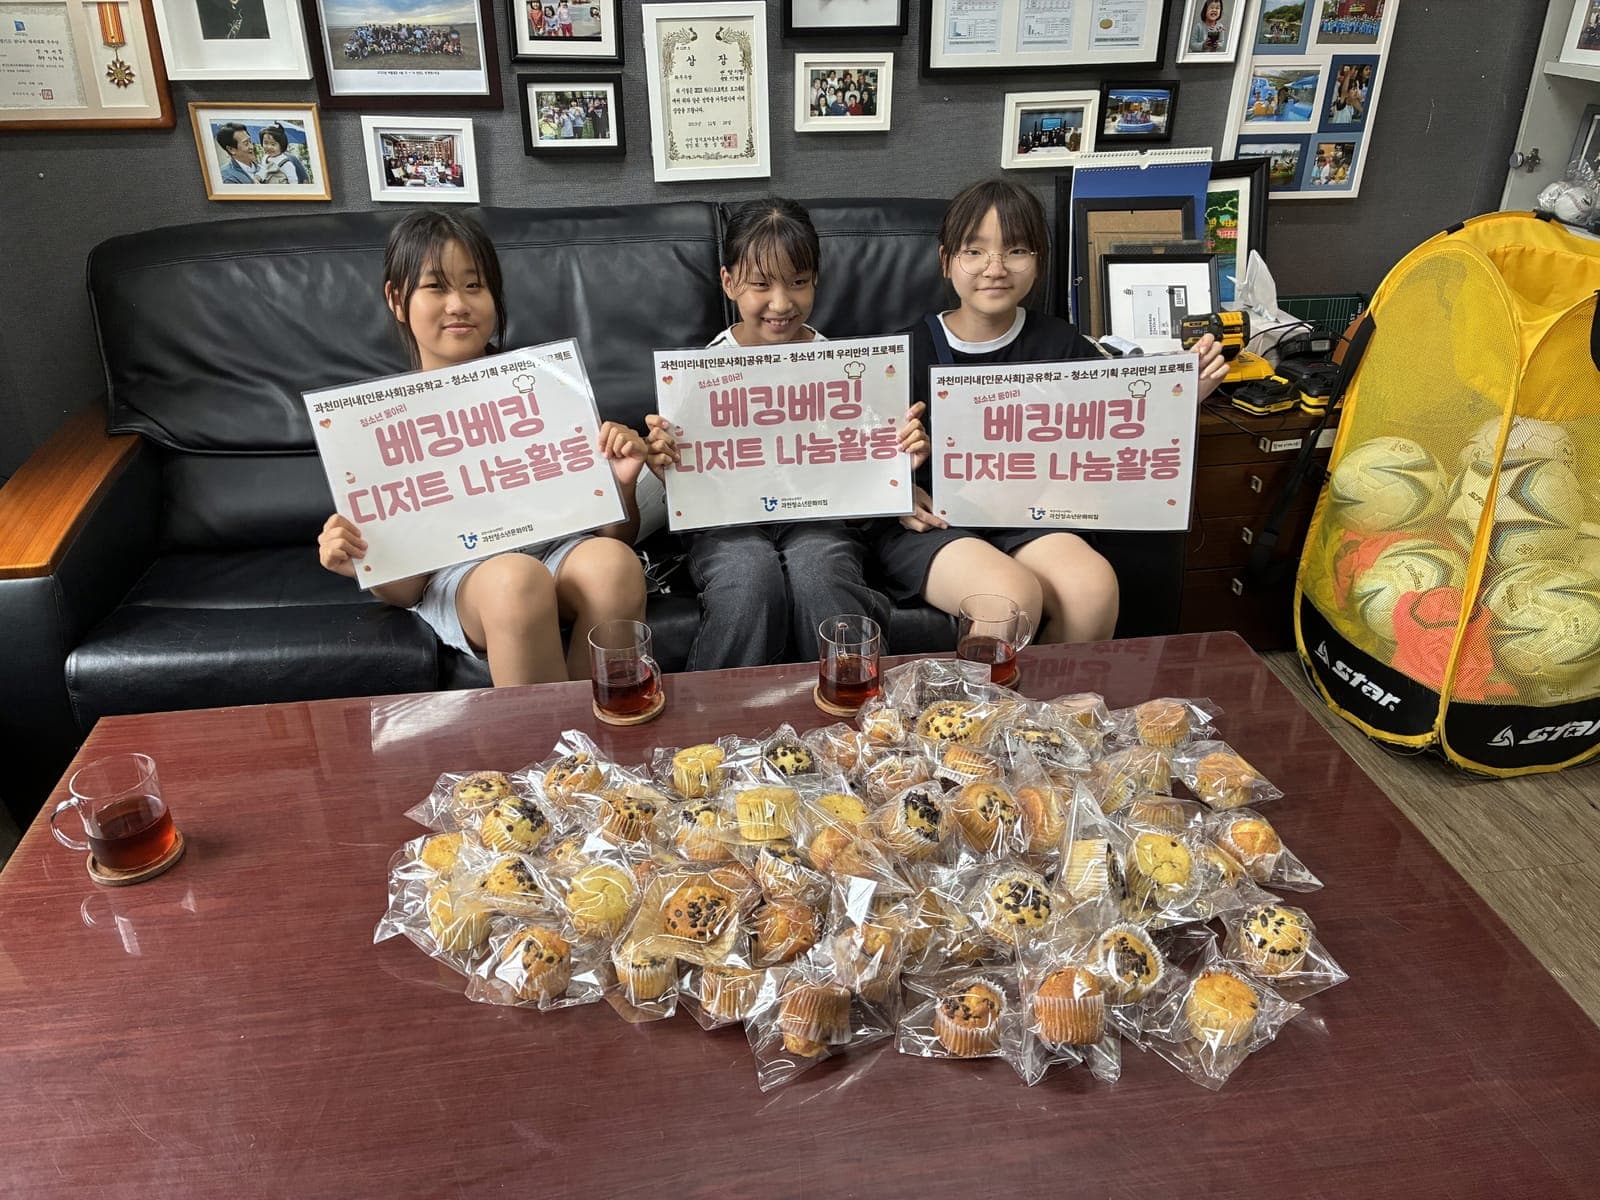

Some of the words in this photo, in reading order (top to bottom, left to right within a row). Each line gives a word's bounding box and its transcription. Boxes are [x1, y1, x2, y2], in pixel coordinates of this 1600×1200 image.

[660, 354, 781, 370] 과천미리내[인문사회]공유학교
[790, 351, 815, 362] 청소년
[817, 349, 834, 360] 기획
[836, 346, 870, 359] 우리만의
[872, 344, 905, 356] 프로젝트
[936, 372, 1062, 386] 과천미리내[인문사회]공유학교
[1071, 369, 1098, 380] 청소년
[1100, 368, 1119, 378] 기획
[1120, 365, 1157, 377] 우리만의
[1159, 362, 1193, 374] 프로젝트
[313, 379, 443, 413] 과천미리내[인문사회]공유학교
[451, 372, 479, 386] 청소년
[480, 367, 499, 379] 기획
[500, 360, 536, 375] 우리만의
[538, 350, 573, 366] 젝트
[698, 378, 720, 389] 청소년
[721, 372, 743, 384] 동아리
[974, 394, 996, 404] 청소년
[998, 389, 1020, 401] 동아리
[360, 410, 383, 427] 청소년
[384, 403, 407, 419] 동아리
[709, 379, 863, 428] 베킹베킹
[983, 398, 1146, 443] 베킹베킹
[375, 391, 545, 467] 베킹베킹
[675, 437, 766, 474] 디저트
[776, 426, 900, 466] 나눔활동
[346, 470, 454, 524] 디저트
[459, 434, 595, 496] 나눔활동
[943, 452, 1037, 482] 디저트
[1049, 446, 1182, 482] 나눔활동
[1332, 660, 1401, 708] star
